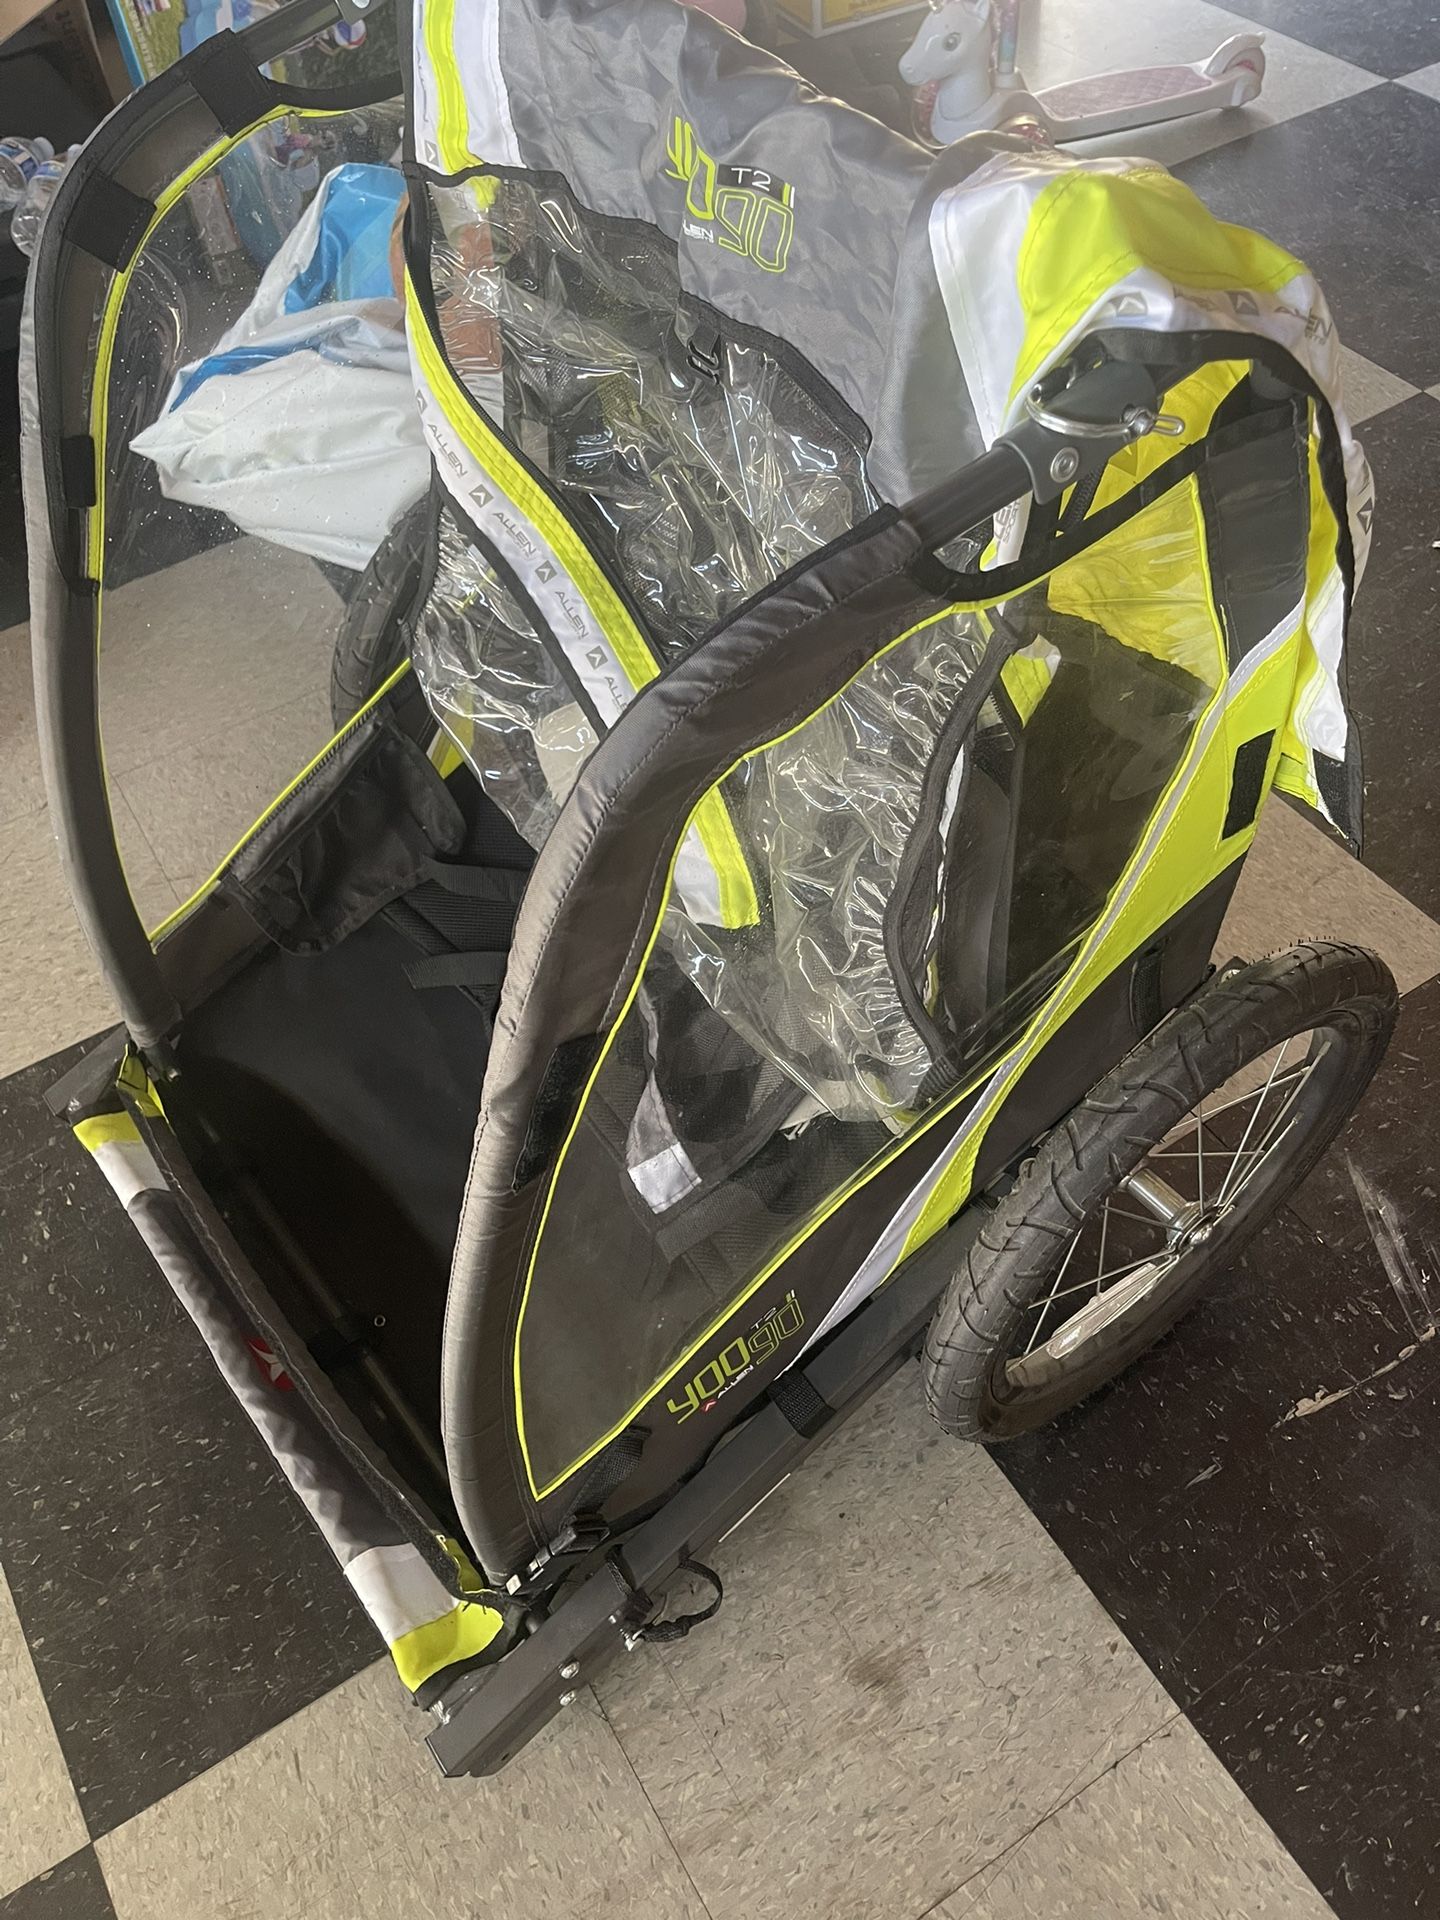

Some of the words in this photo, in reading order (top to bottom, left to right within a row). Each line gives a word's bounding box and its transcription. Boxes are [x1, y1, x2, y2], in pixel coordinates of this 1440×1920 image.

[731, 167, 771, 191] T2
[682, 219, 714, 242] LEN
[428, 423, 467, 476] ALLEN
[492, 512, 536, 556] ALLEN
[554, 590, 589, 638] ALLEN
[604, 676, 628, 710] ALLE
[750, 1306, 777, 1329] T2
